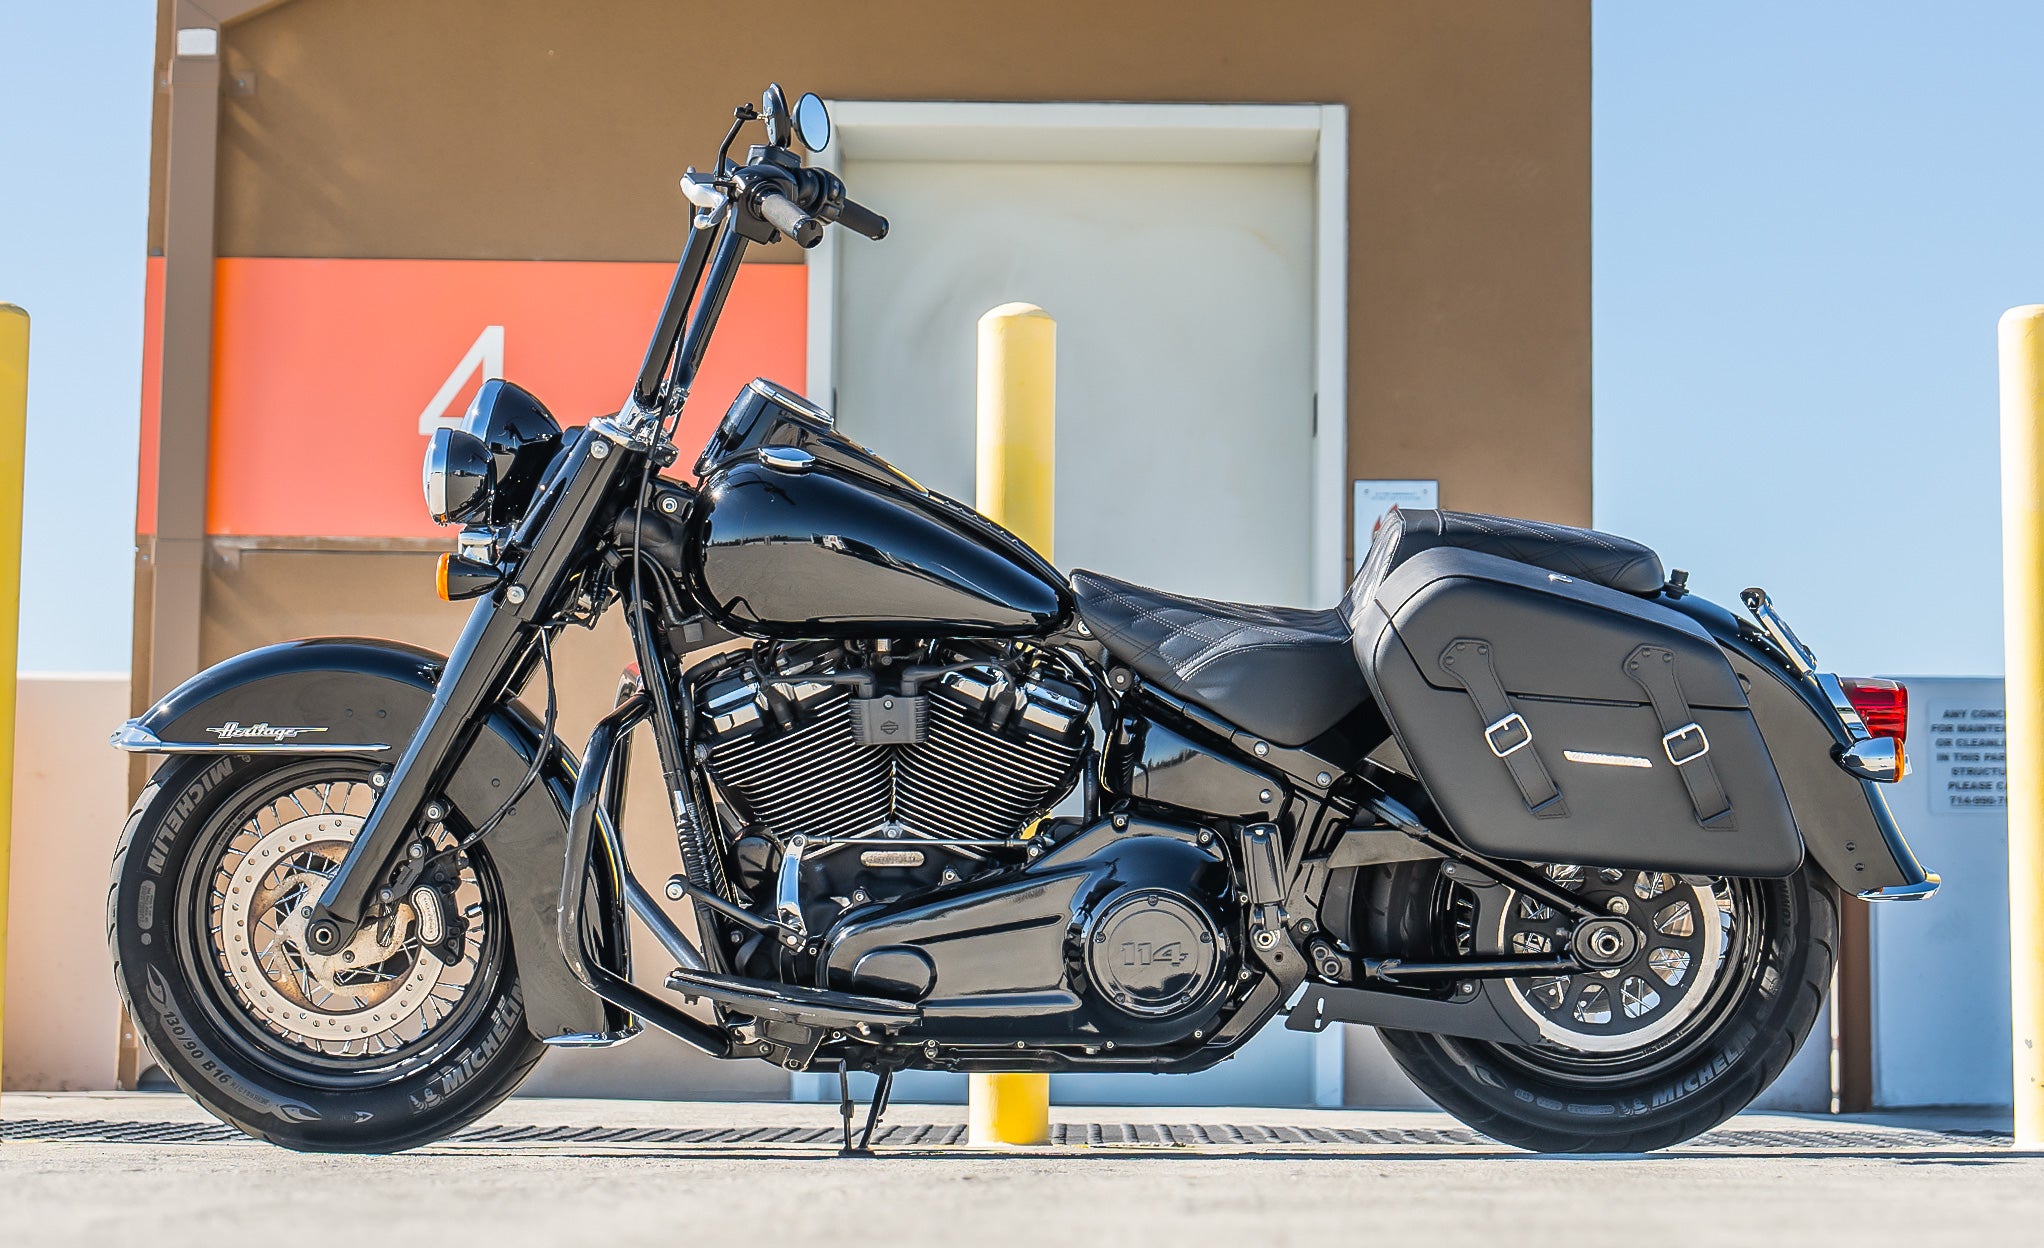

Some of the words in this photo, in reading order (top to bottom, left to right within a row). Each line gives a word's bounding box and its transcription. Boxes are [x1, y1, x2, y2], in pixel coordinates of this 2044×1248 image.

[418, 325, 504, 436] 4
[1942, 709, 1968, 719] ANY
[1970, 709, 2006, 719] CONC
[214, 721, 303, 741] Heritage
[1930, 724, 1954, 733] FOR
[1935, 738, 1953, 747] OR
[1984, 753, 2006, 762] PAR
[1951, 767, 2006, 776] STRUCTU
[1947, 781, 1993, 791] PLEASE
[146, 756, 234, 875] MICHELIN
[1121, 941, 1189, 967] 114
[163, 1010, 204, 1060] 130/90
[201, 1060, 232, 1083] B16
